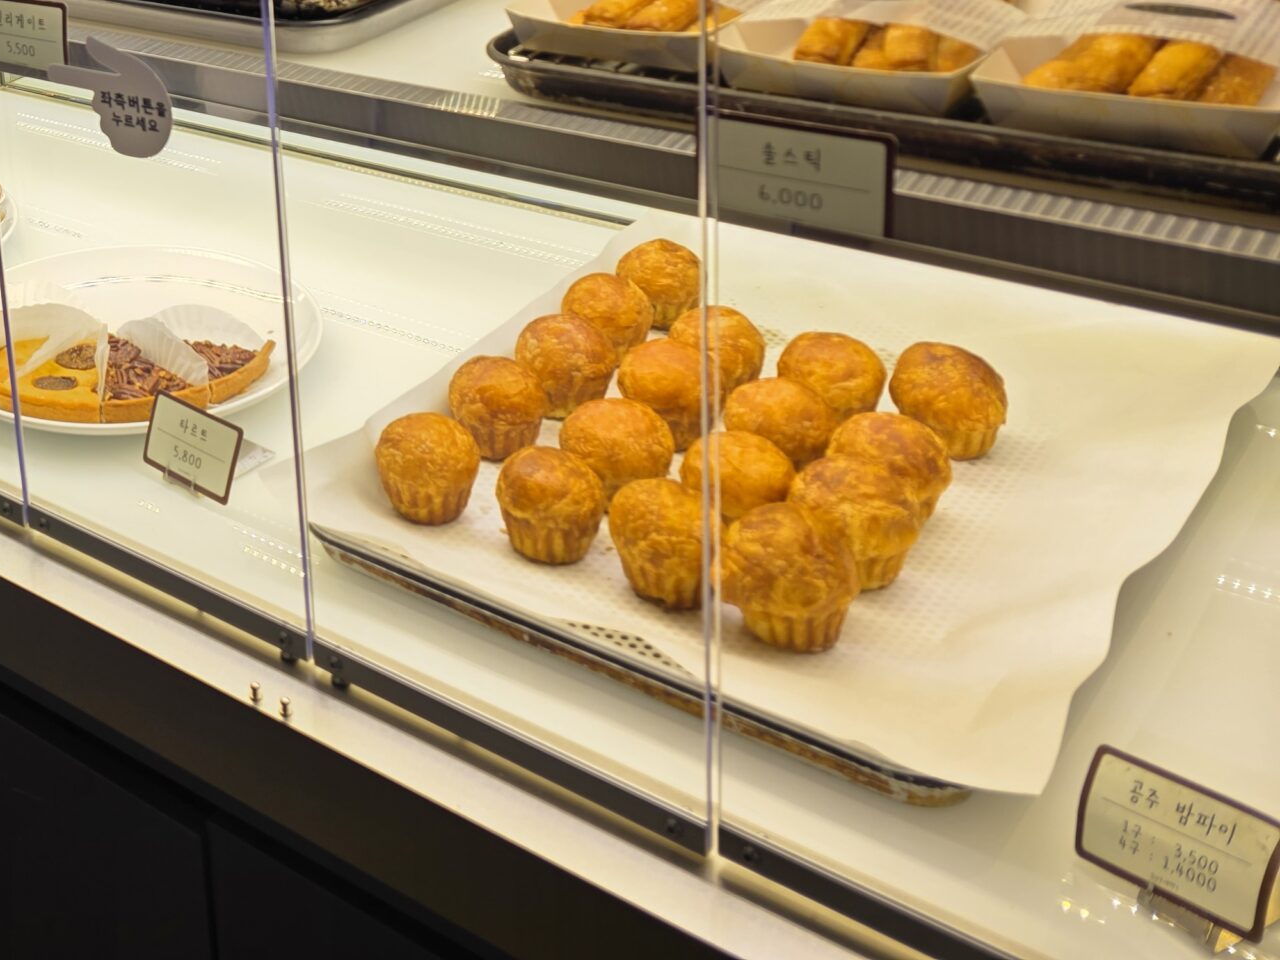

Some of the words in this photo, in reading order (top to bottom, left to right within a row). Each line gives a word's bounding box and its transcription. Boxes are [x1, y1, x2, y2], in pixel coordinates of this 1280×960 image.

[100, 90, 167, 118] 좌측버튼을
[111, 112, 160, 133] 누르세요
[179, 418, 208, 442] 타르트
[173, 444, 202, 470] 5,800
[1128, 779, 1160, 809] 공주
[1175, 801, 1237, 846] 밤파이
[1174, 842, 1219, 876] 3,500
